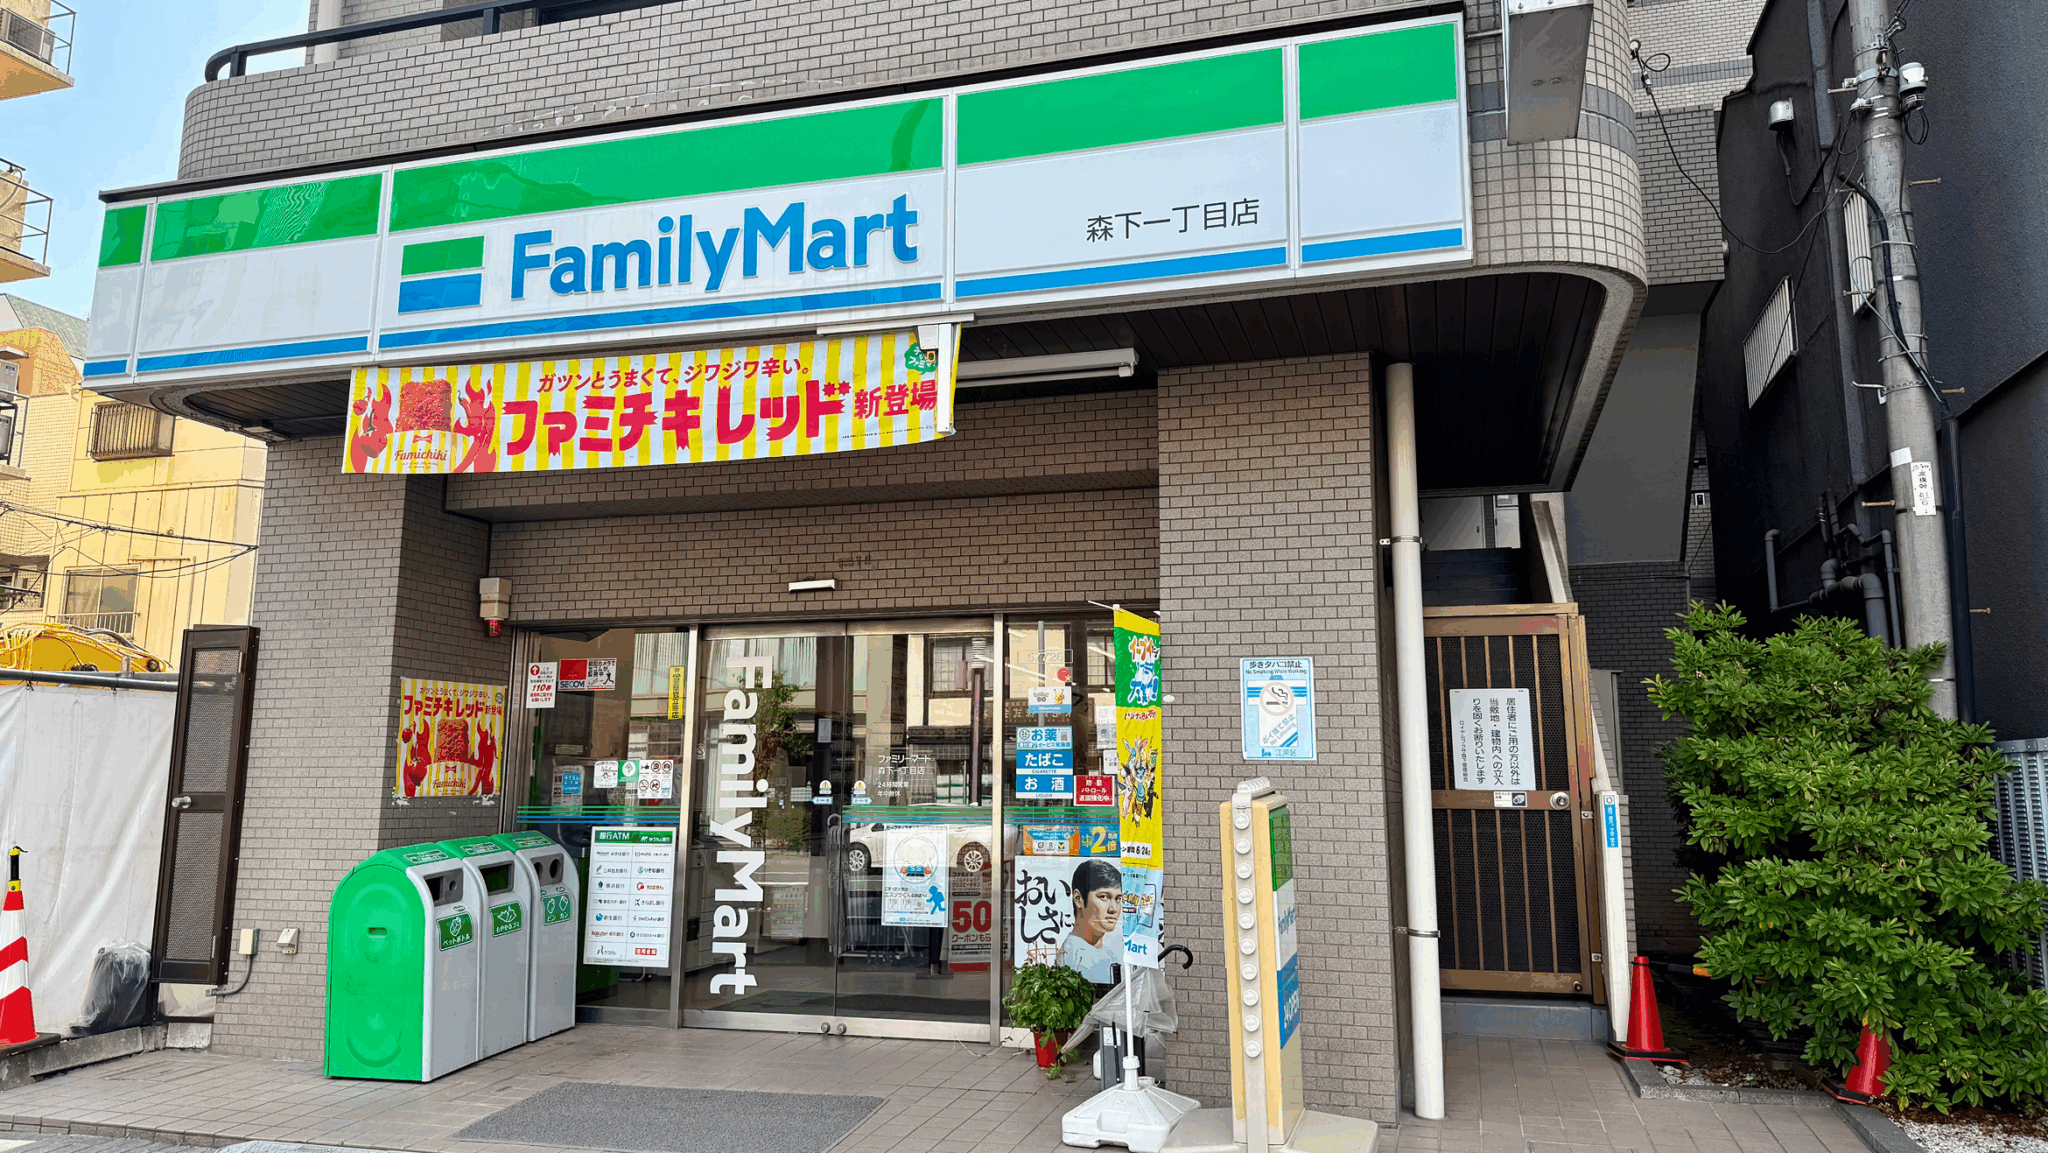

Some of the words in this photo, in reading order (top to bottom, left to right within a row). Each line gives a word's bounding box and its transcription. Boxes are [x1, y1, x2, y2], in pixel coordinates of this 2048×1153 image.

[1086, 198, 1260, 243] 森下一丁目店
[510, 193, 919, 300] FamilyMart
[538, 356, 811, 394] ガツンとうまくて、ジワジワ辛い。
[854, 380, 937, 420] 新登場
[503, 380, 852, 457] ファミチキレッド
[393, 447, 448, 463] Famichiki
[1249, 660, 1303, 669] 歩きタバコ禁止
[560, 680, 585, 688] SECOM
[403, 695, 485, 718] ファミチキレッド
[1031, 728, 1057, 741] お薬
[1262, 713, 1295, 744] ポイ捨て禁止
[1473, 698, 1486, 785] りを固くお断りいたします
[1489, 698, 1504, 786] 当敷地・建物内への立入
[1506, 697, 1521, 786] 居住者にご用の方以外は
[878, 754, 931, 764] ファミリーマート
[878, 766, 925, 775] 森下一丁目店
[1025, 752, 1064, 767] たばこ
[599, 832, 630, 840] 銀行ATM
[710, 656, 773, 995] FamilyMart
[1015, 869, 1071, 906] おい
[952, 900, 992, 933] 50
[442, 933, 471, 945] ペットボトル
